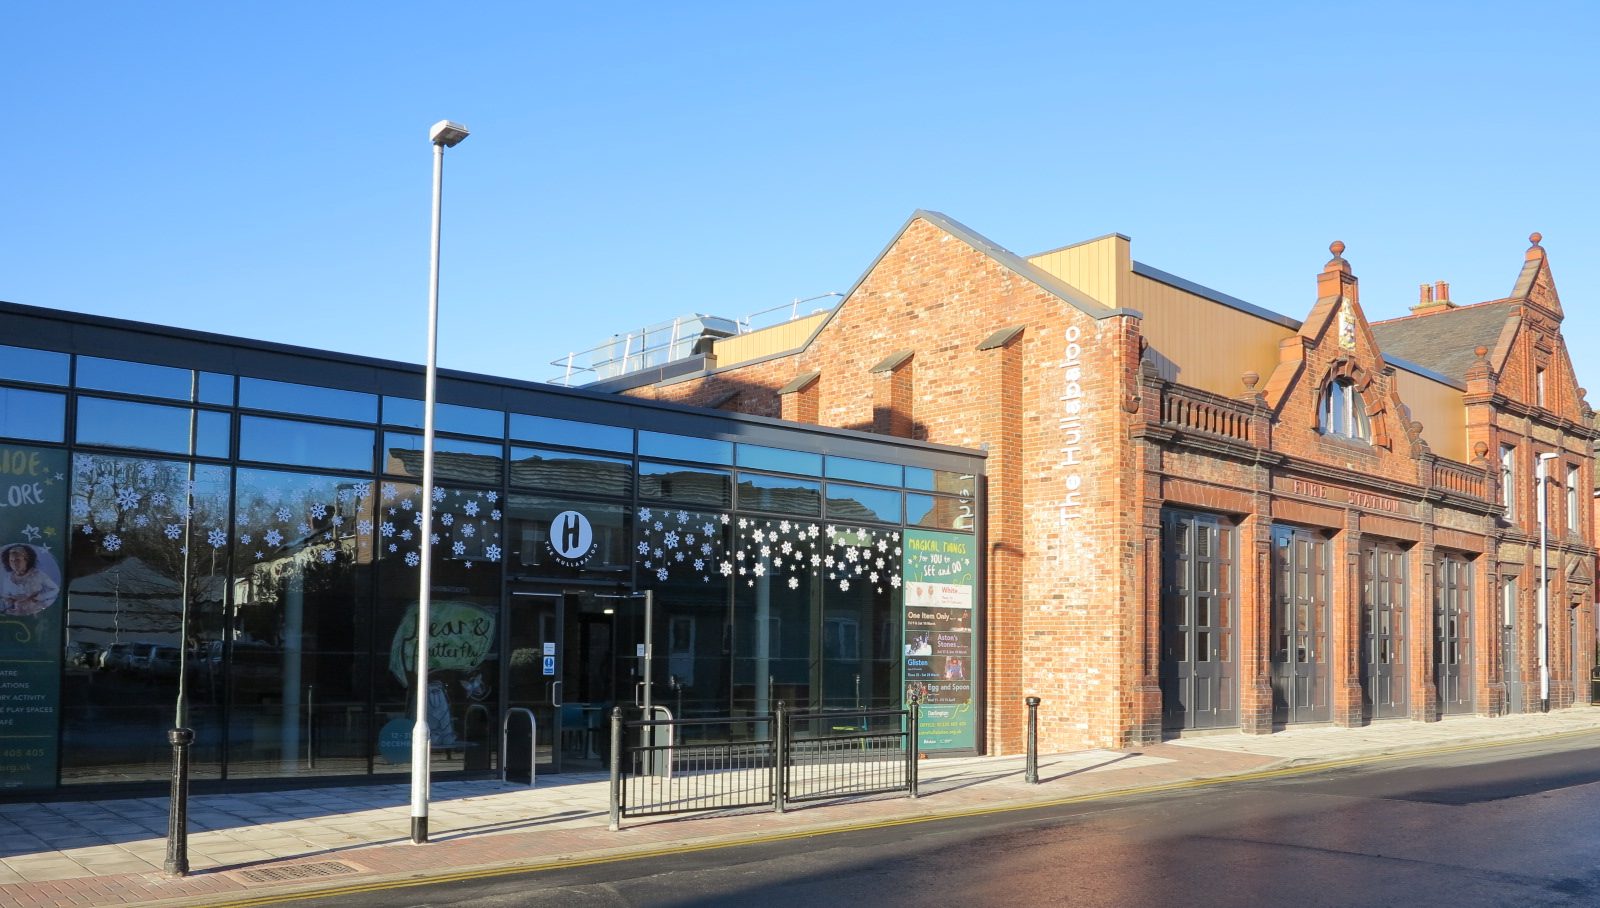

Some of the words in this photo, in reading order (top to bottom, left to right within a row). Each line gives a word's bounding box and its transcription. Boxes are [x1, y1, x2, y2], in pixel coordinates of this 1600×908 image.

[1059, 325, 1082, 467] Hullabaloo
[0, 449, 40, 476] IDE
[1059, 473, 1081, 526] The
[1294, 480, 1327, 499] FIRE
[1348, 491, 1400, 513] STATION
[908, 538, 939, 552] MAGICAL
[420, 616, 465, 638] ear
[908, 611, 920, 619] One
[921, 612, 935, 620] Item
[936, 612, 950, 622] Only
[420, 642, 482, 667] utterfly
[908, 658, 928, 666] Glisten
[928, 683, 939, 692] Egg
[940, 683, 951, 691] and
[952, 683, 970, 693] Spoon
